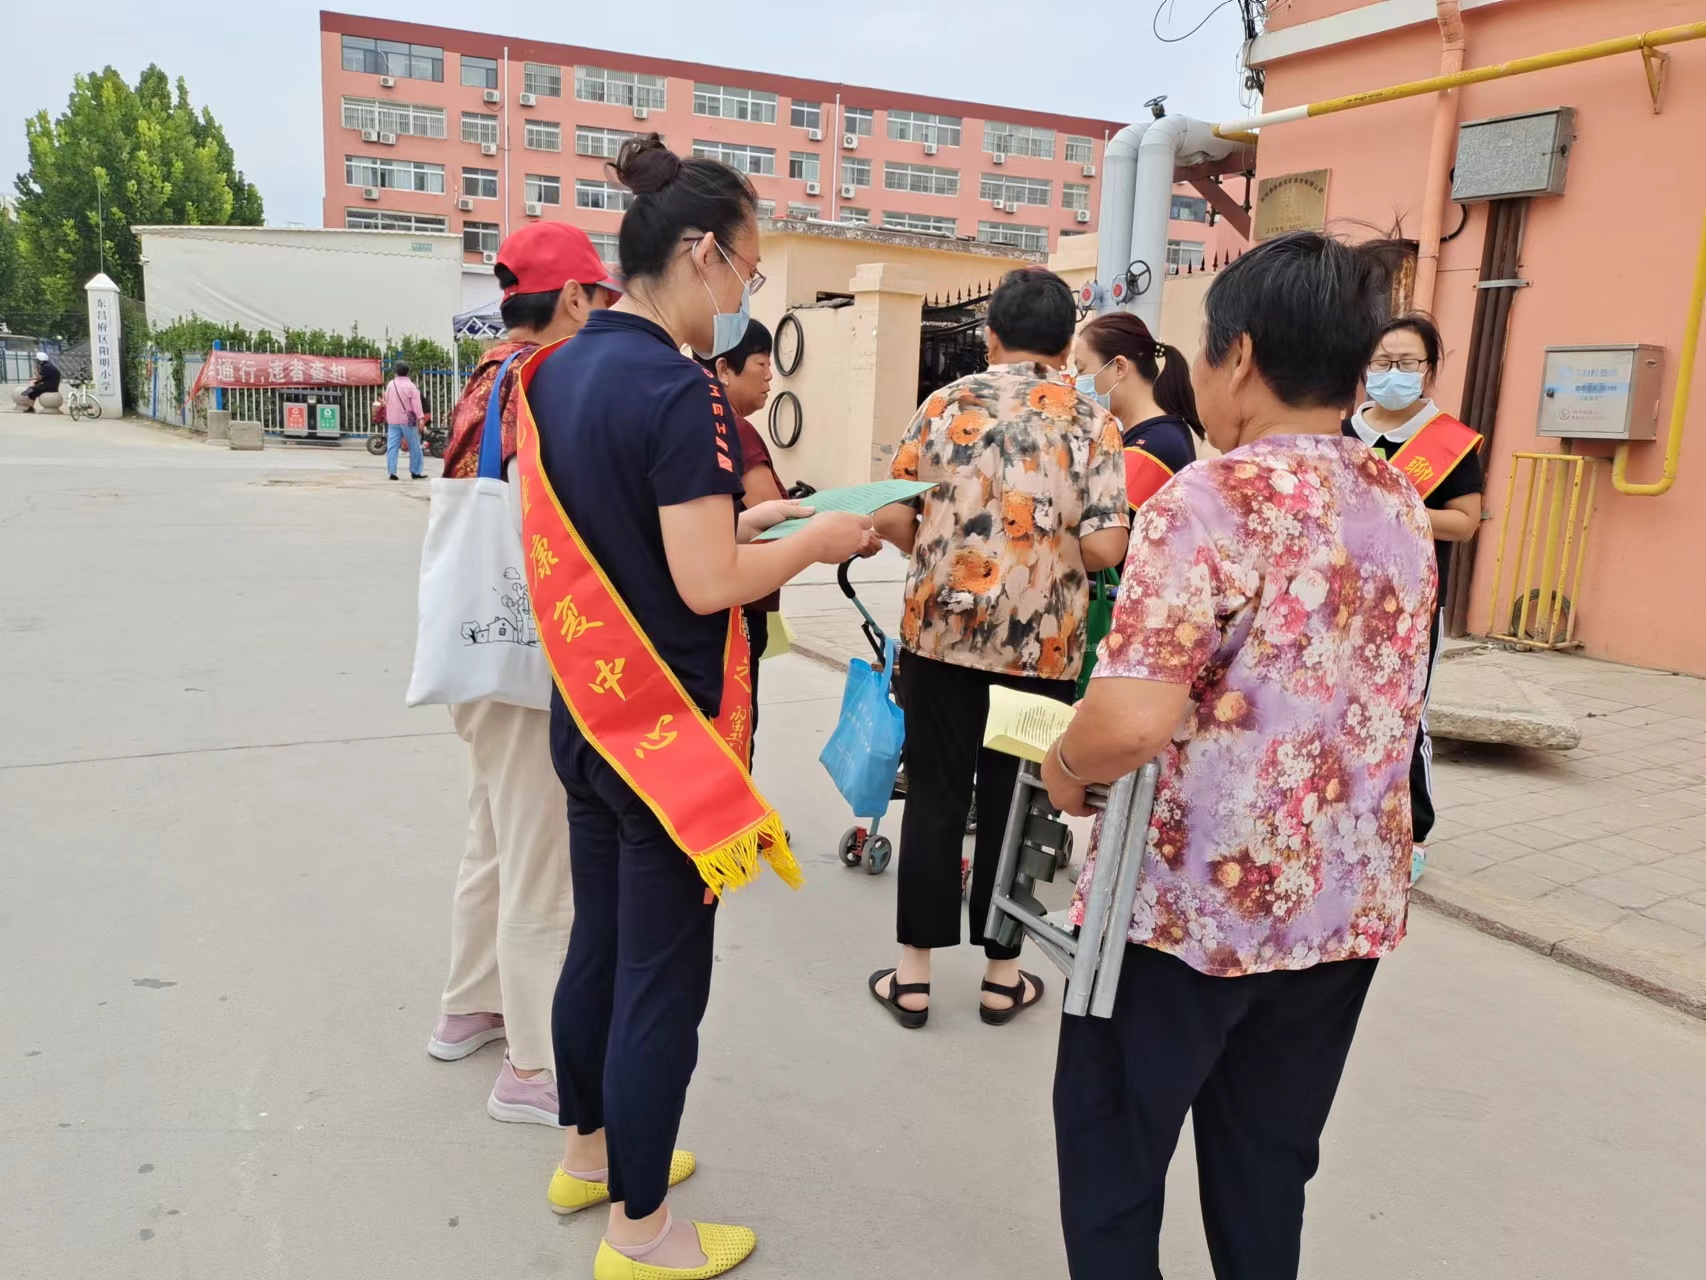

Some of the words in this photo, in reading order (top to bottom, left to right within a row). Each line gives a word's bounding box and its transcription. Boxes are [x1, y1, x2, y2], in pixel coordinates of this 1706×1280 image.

[97, 298, 112, 392] 东昌府区阳明小学
